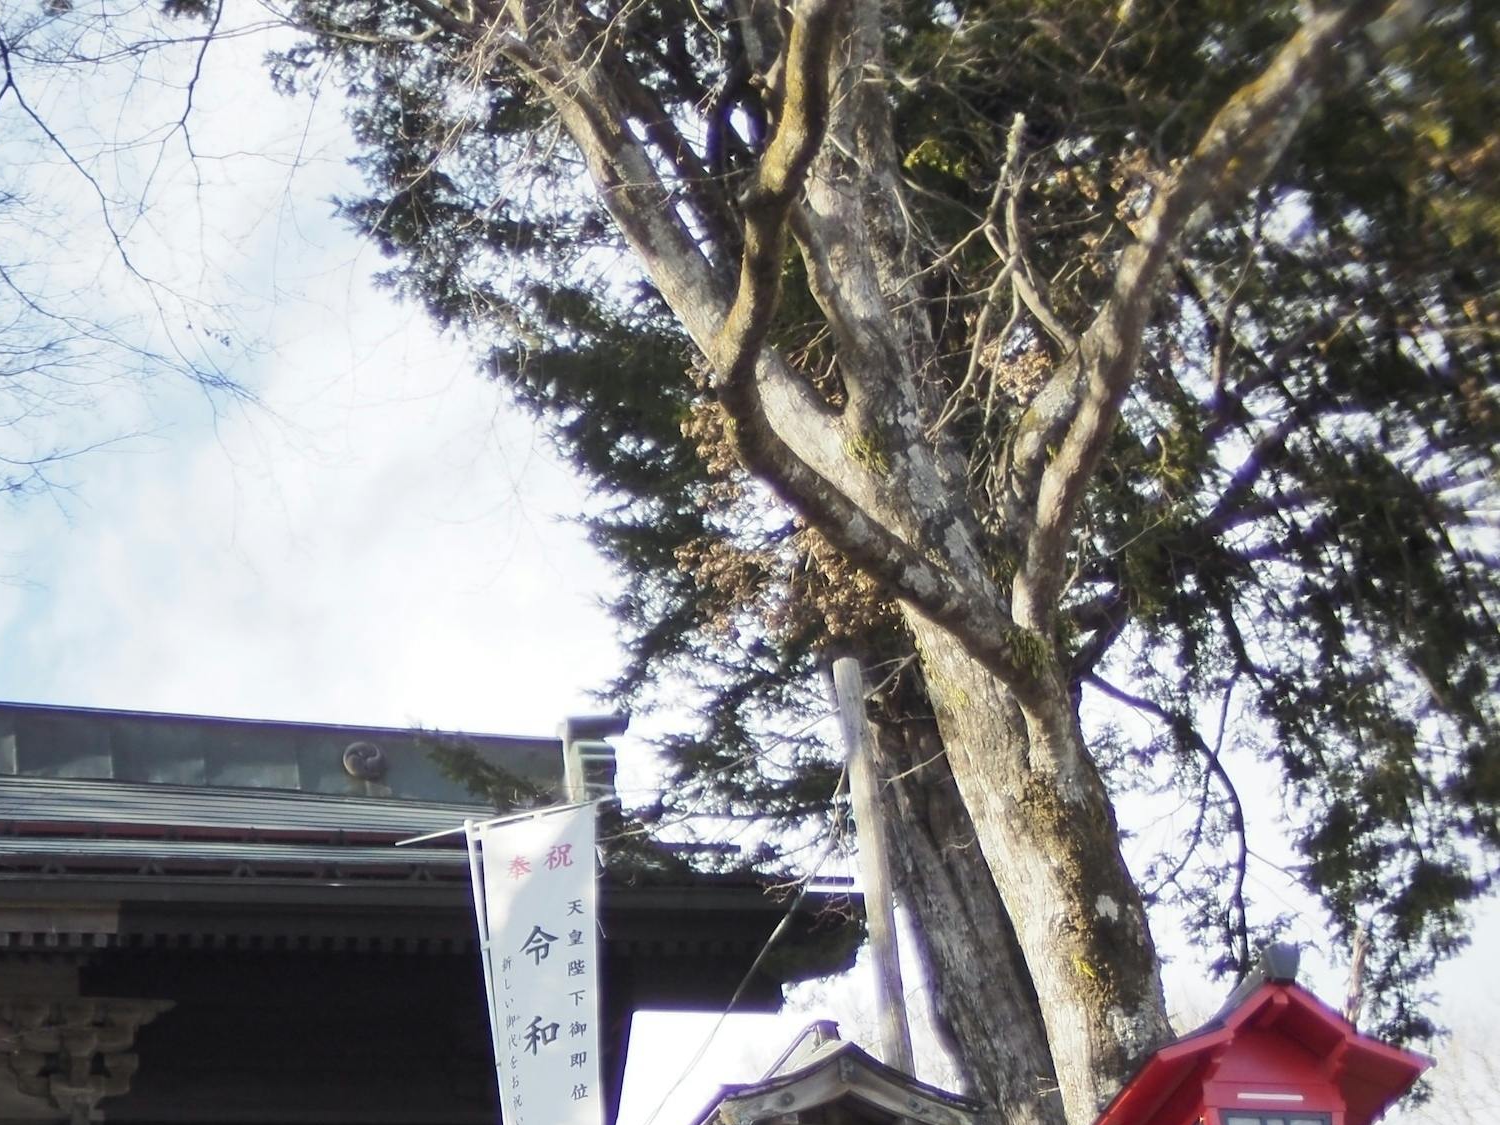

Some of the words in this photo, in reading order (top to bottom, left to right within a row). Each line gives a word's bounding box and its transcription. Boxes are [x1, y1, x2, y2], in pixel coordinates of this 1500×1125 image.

[507, 842, 575, 881] 奉祝
[518, 924, 561, 1057] 令和
[566, 898, 590, 1101] 天皇陛下御即位
